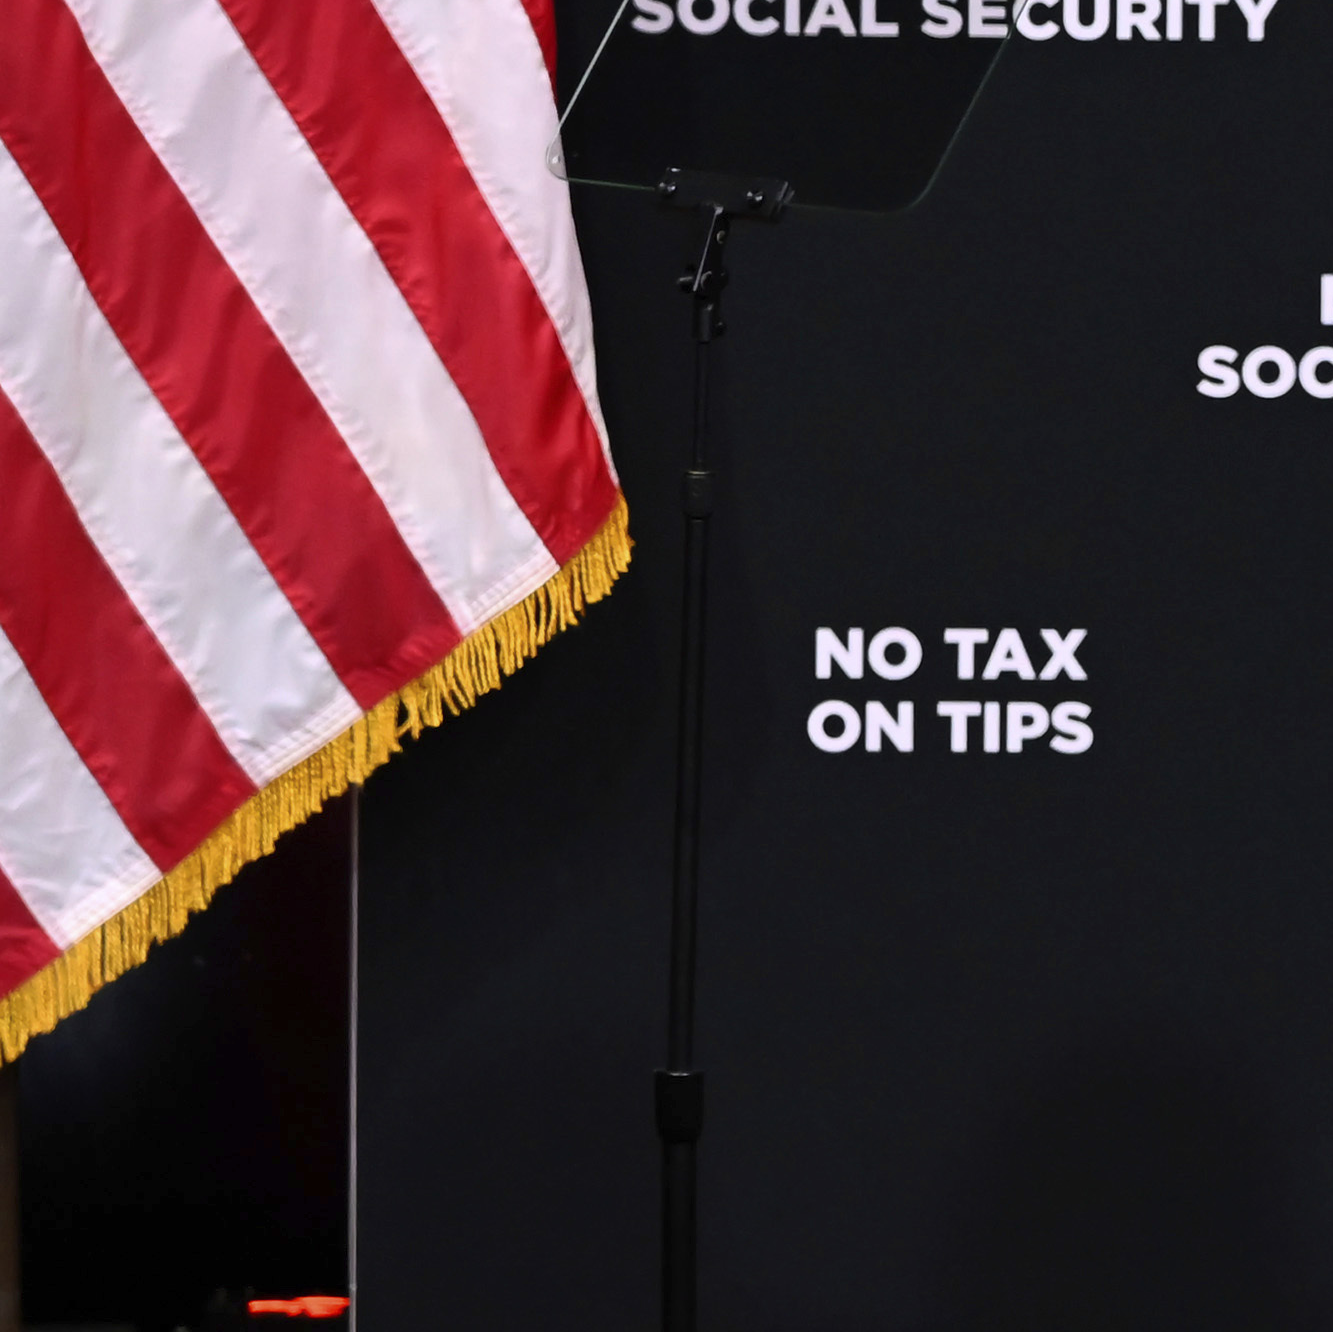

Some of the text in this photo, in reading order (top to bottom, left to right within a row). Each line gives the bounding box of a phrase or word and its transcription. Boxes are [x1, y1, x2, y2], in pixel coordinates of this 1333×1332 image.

[816, 627, 1087, 680] NO TAX
[807, 700, 1093, 753] ON TIPS
